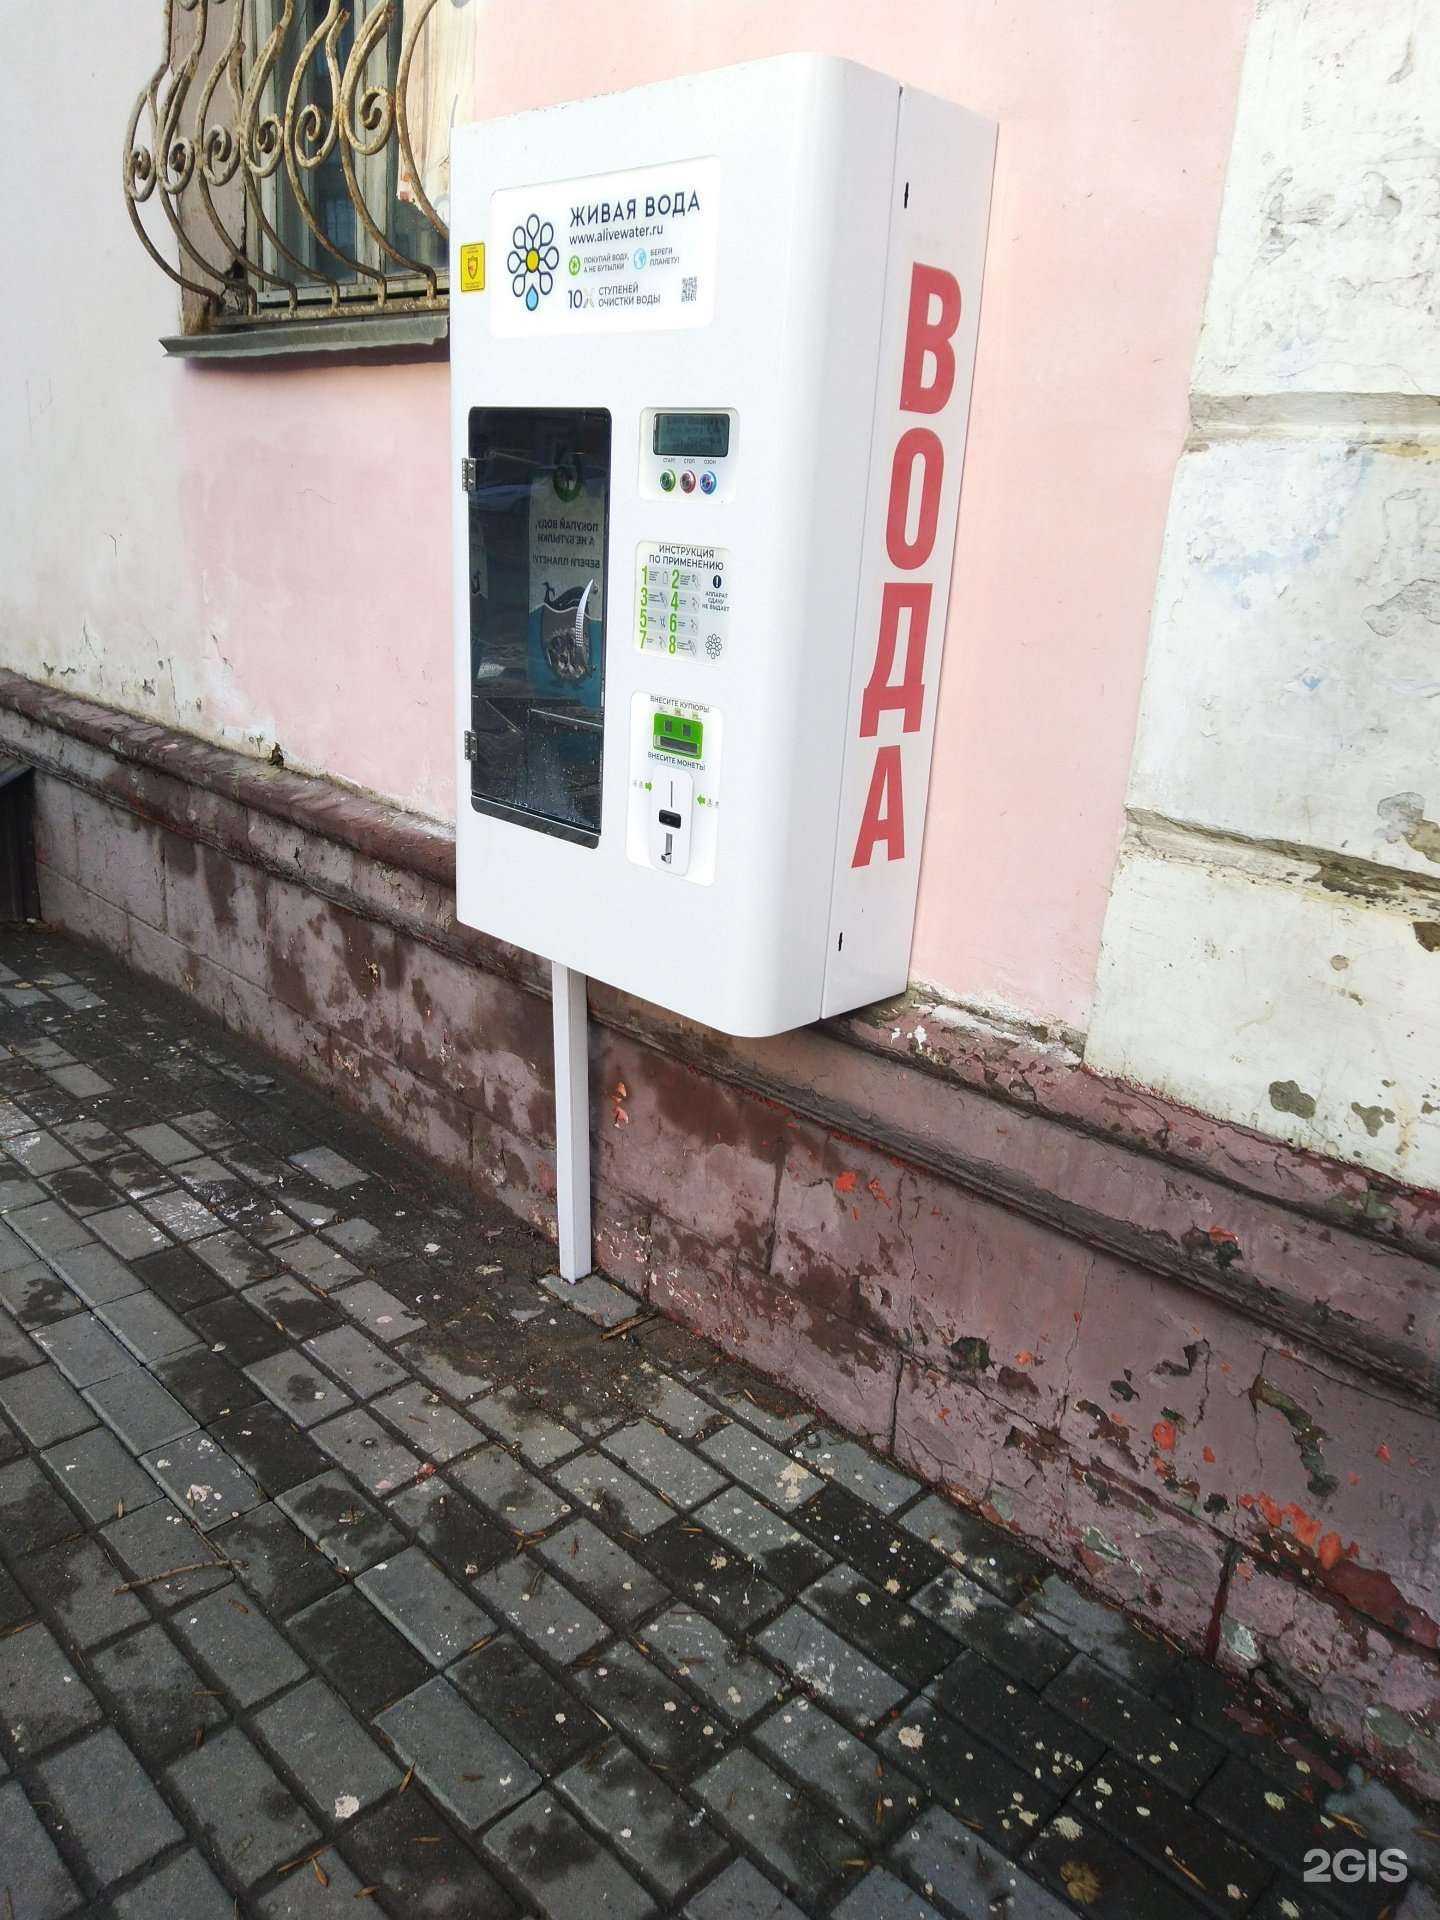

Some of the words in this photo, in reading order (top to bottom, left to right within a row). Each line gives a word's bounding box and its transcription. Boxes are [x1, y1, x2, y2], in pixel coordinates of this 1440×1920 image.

[570, 199, 636, 228] ЖИВАЯ
[645, 189, 700, 218] ВОДА
[569, 224, 664, 245] www.alivewater.ru
[584, 254, 611, 264] ПОКУПАЙ
[650, 247, 673, 256] БЕРЕГИ
[598, 264, 624, 272] БУТЫЛКИ
[650, 256, 680, 266] ПЛАНЕТУ!
[598, 282, 638, 296] СТУПЕНЕЙ
[598, 296, 634, 308] ОЧИСТКИ
[636, 294, 661, 305] ВОДЫ
[660, 545, 714, 558] ИНСТРУКЦИЯ
[650, 554, 660, 564] ПО
[662, 556, 724, 570] ПРИМЕНЕНИЮ
[852, 262, 962, 868] ВОДА
[642, 566, 648, 584] 1
[672, 569, 680, 589] 2
[640, 587, 648, 606] 3
[670, 592, 679, 611] 4
[640, 610, 647, 628] 5
[670, 614, 677, 632] 6
[640, 630, 647, 648] 7
[668, 635, 676, 654] 8
[650, 696, 678, 707] ВНЕСИТЕ
[680, 702, 710, 712] КУПЮРЫ
[648, 752, 676, 764] ВНЕСИТЕ
[677, 759, 706, 770] МОНЕТЫ
